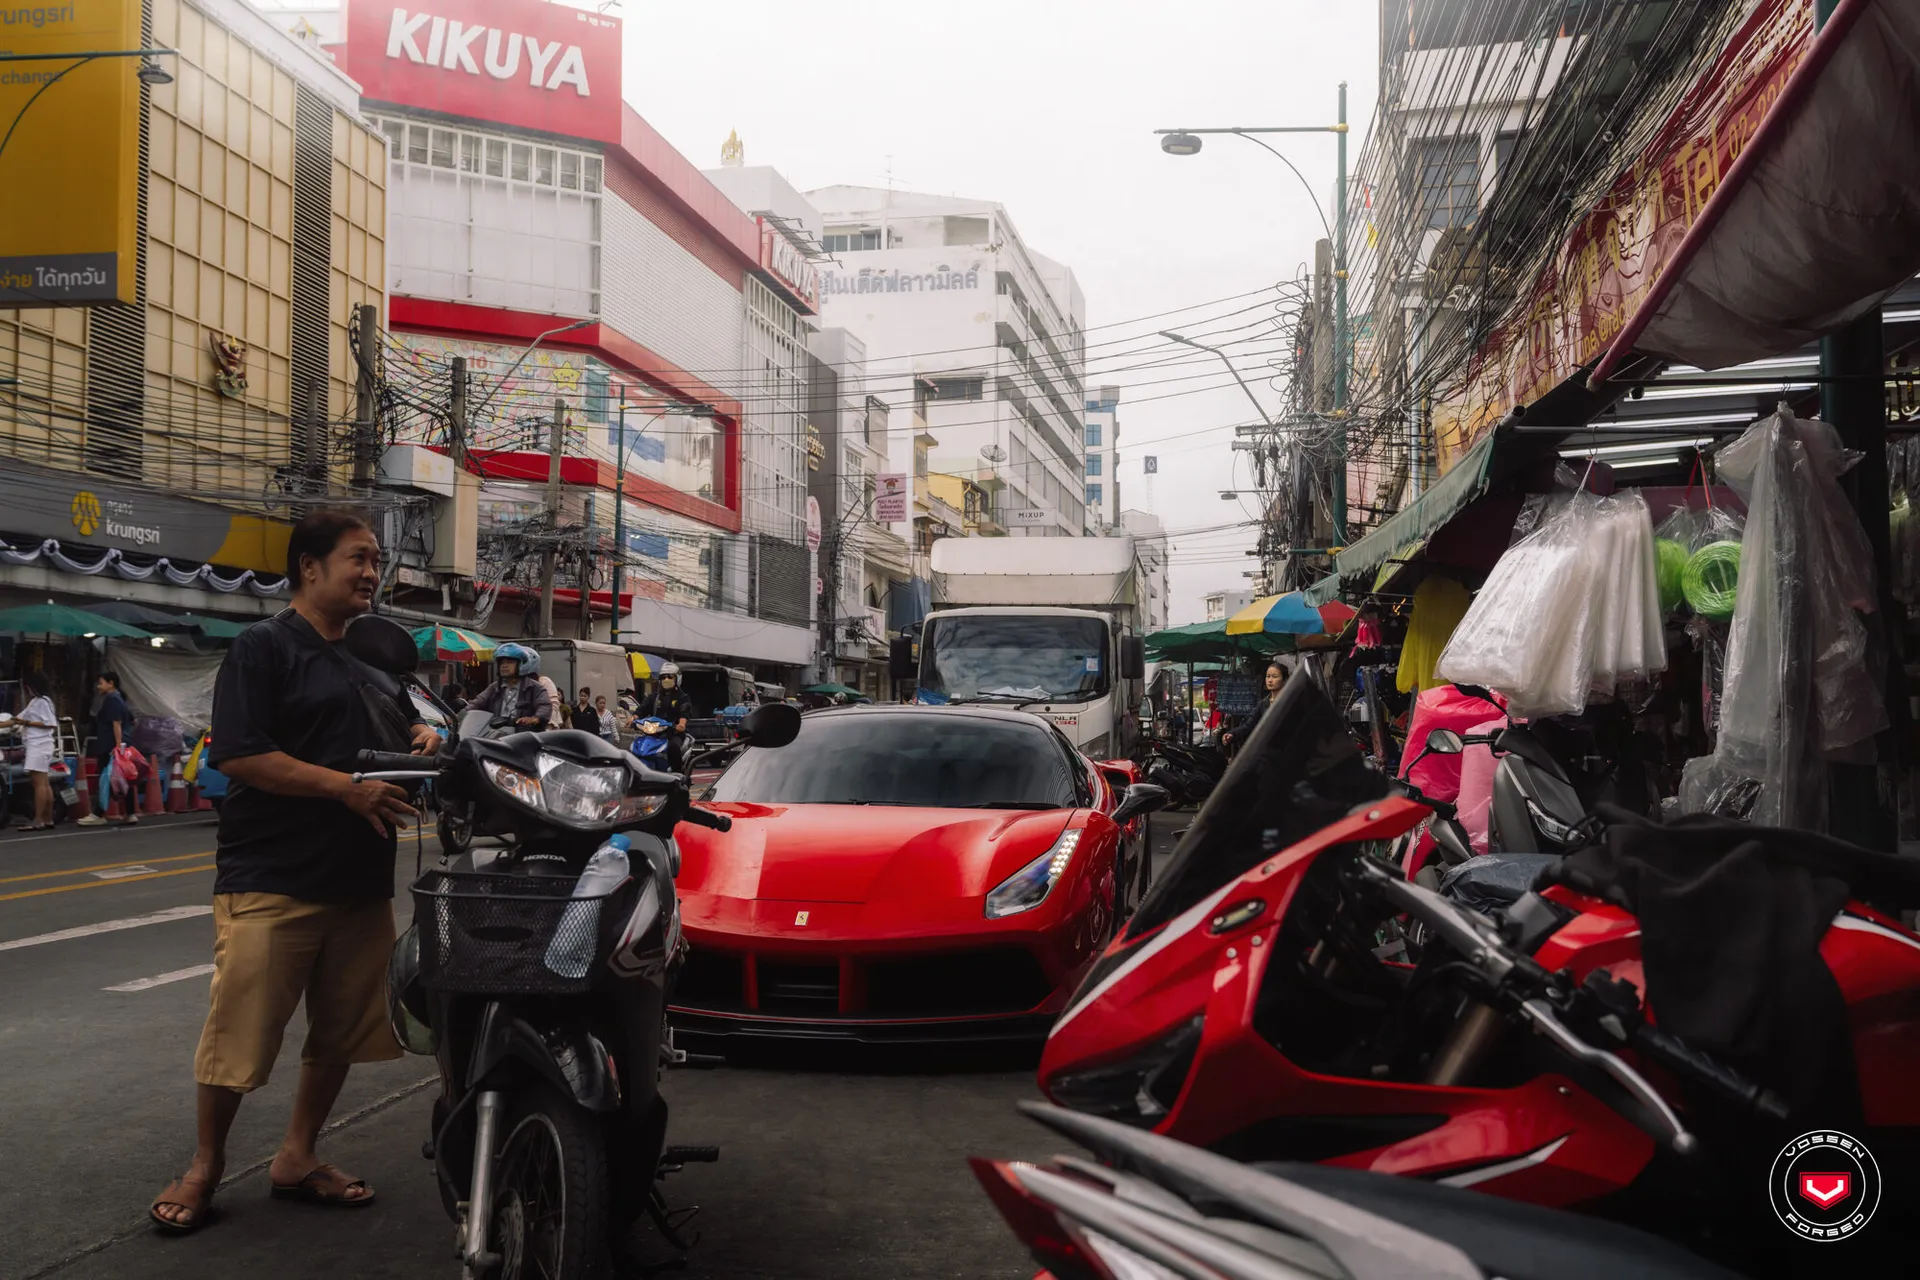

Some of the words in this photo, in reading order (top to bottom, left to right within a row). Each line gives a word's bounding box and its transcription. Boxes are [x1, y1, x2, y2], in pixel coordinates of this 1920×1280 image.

[386, 8, 590, 96] KIKUYA
[35, 267, 107, 292] ได้ทุกวัน
[106, 515, 160, 545] krungsri
[522, 854, 567, 862] HONDA
